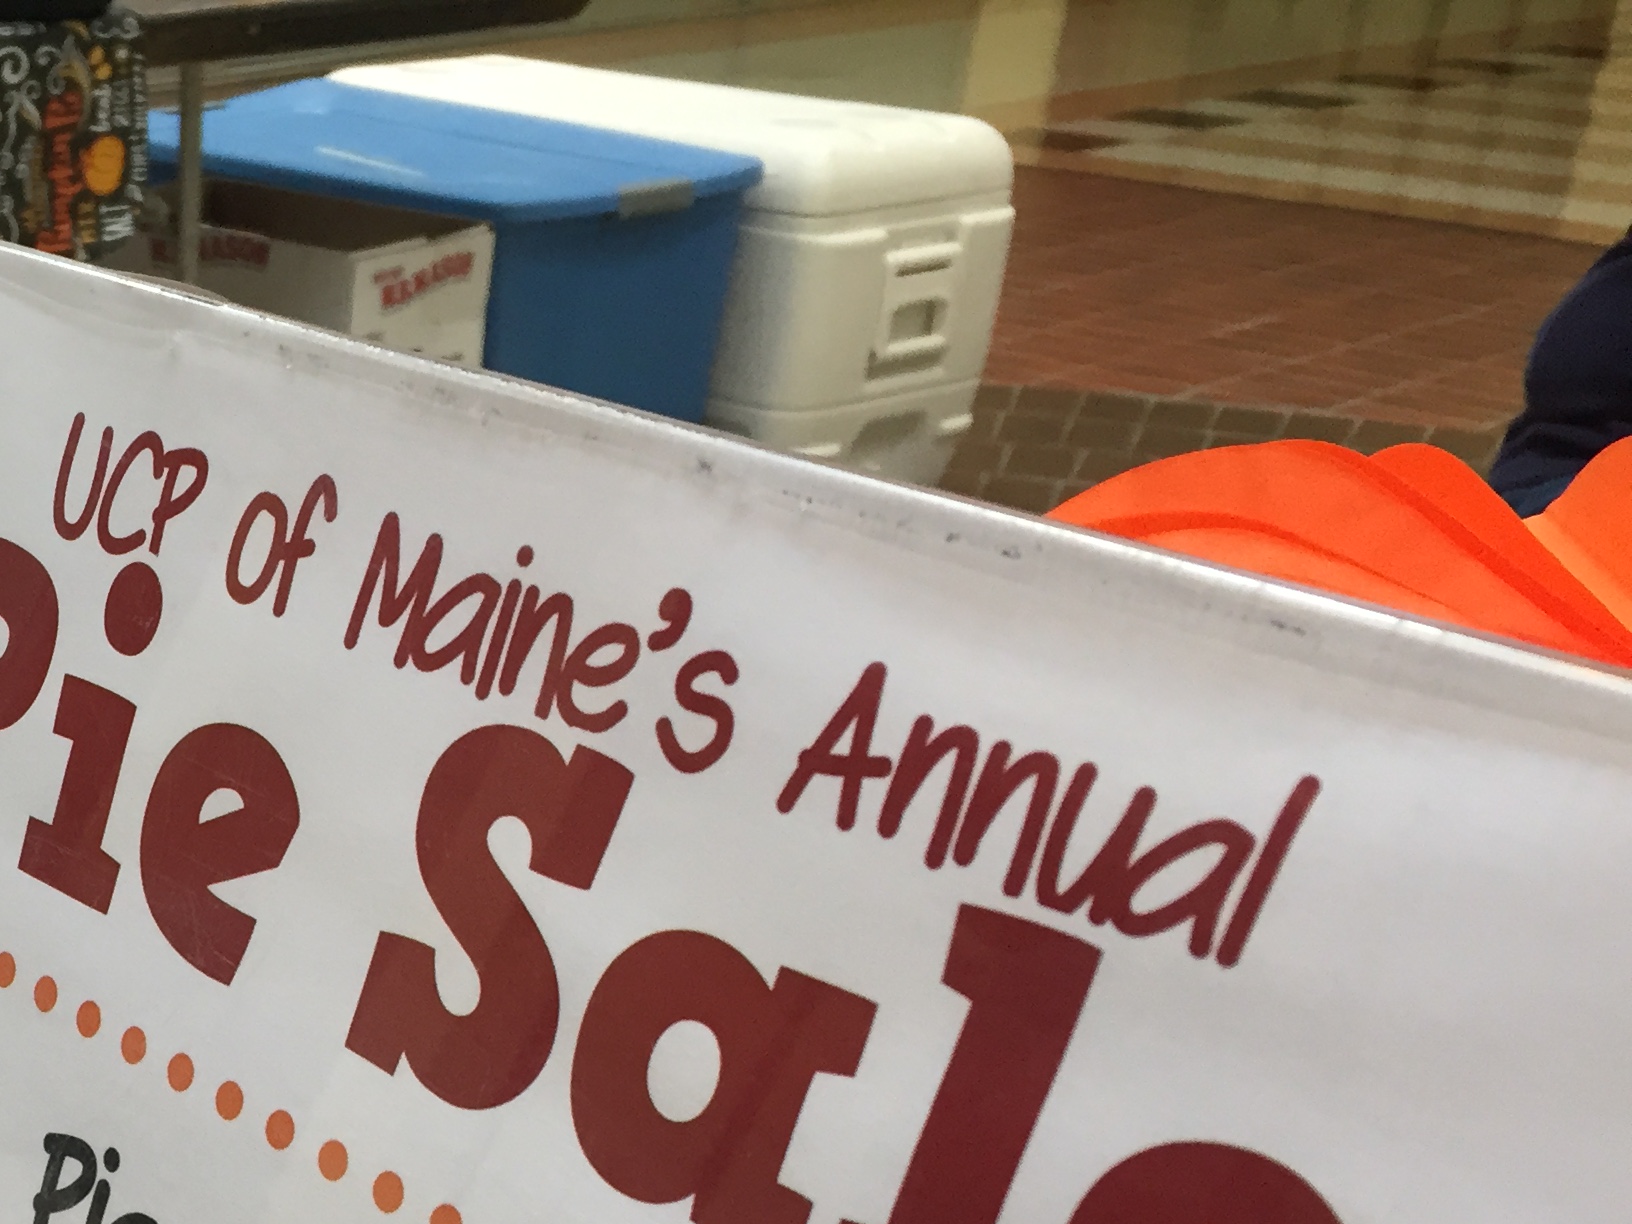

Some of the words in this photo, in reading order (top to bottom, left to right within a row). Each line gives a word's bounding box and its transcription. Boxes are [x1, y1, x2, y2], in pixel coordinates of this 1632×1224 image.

[52, 410, 209, 557] UCP
[343, 511, 741, 774] Maine's
[776, 661, 1322, 969] Annual
